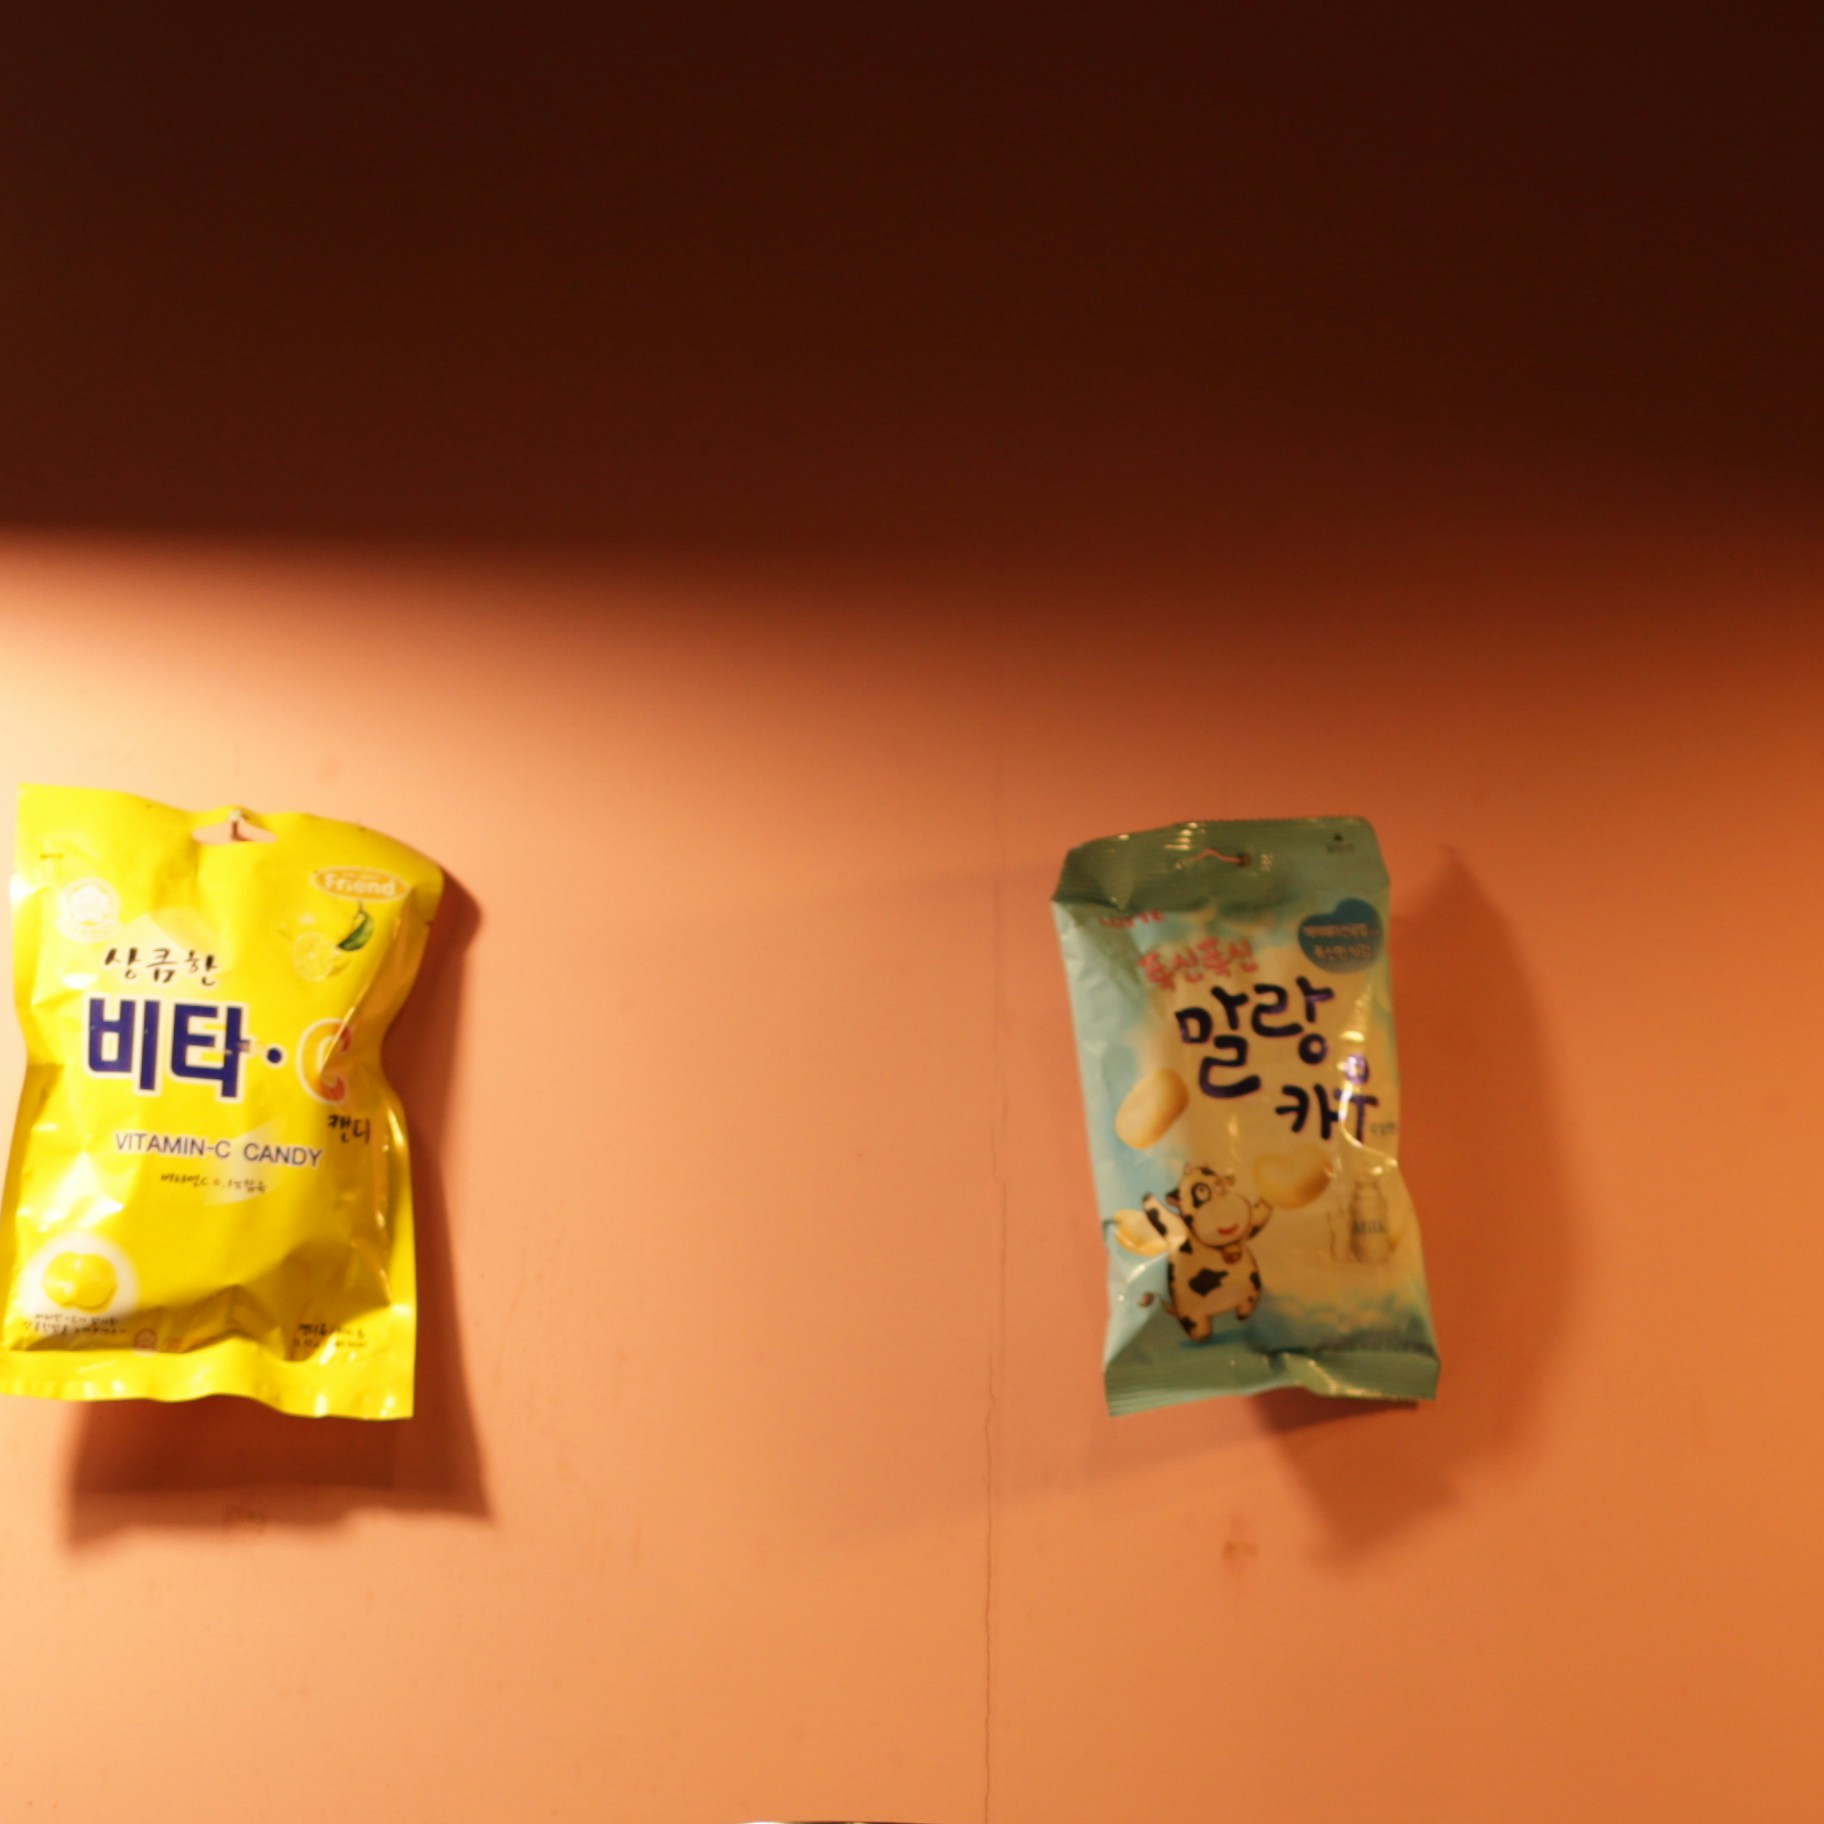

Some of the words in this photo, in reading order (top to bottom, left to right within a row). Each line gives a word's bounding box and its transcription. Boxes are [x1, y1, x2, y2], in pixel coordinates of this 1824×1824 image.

[323, 874, 397, 897] Friend
[103, 944, 220, 987] 상큼한
[1174, 975, 1334, 1099] 말랑
[1274, 1053, 1380, 1142] 카우
[326, 1112, 372, 1146] 캔디
[115, 1132, 232, 1160] VITAMIN-C
[242, 1142, 324, 1168] CANDY
